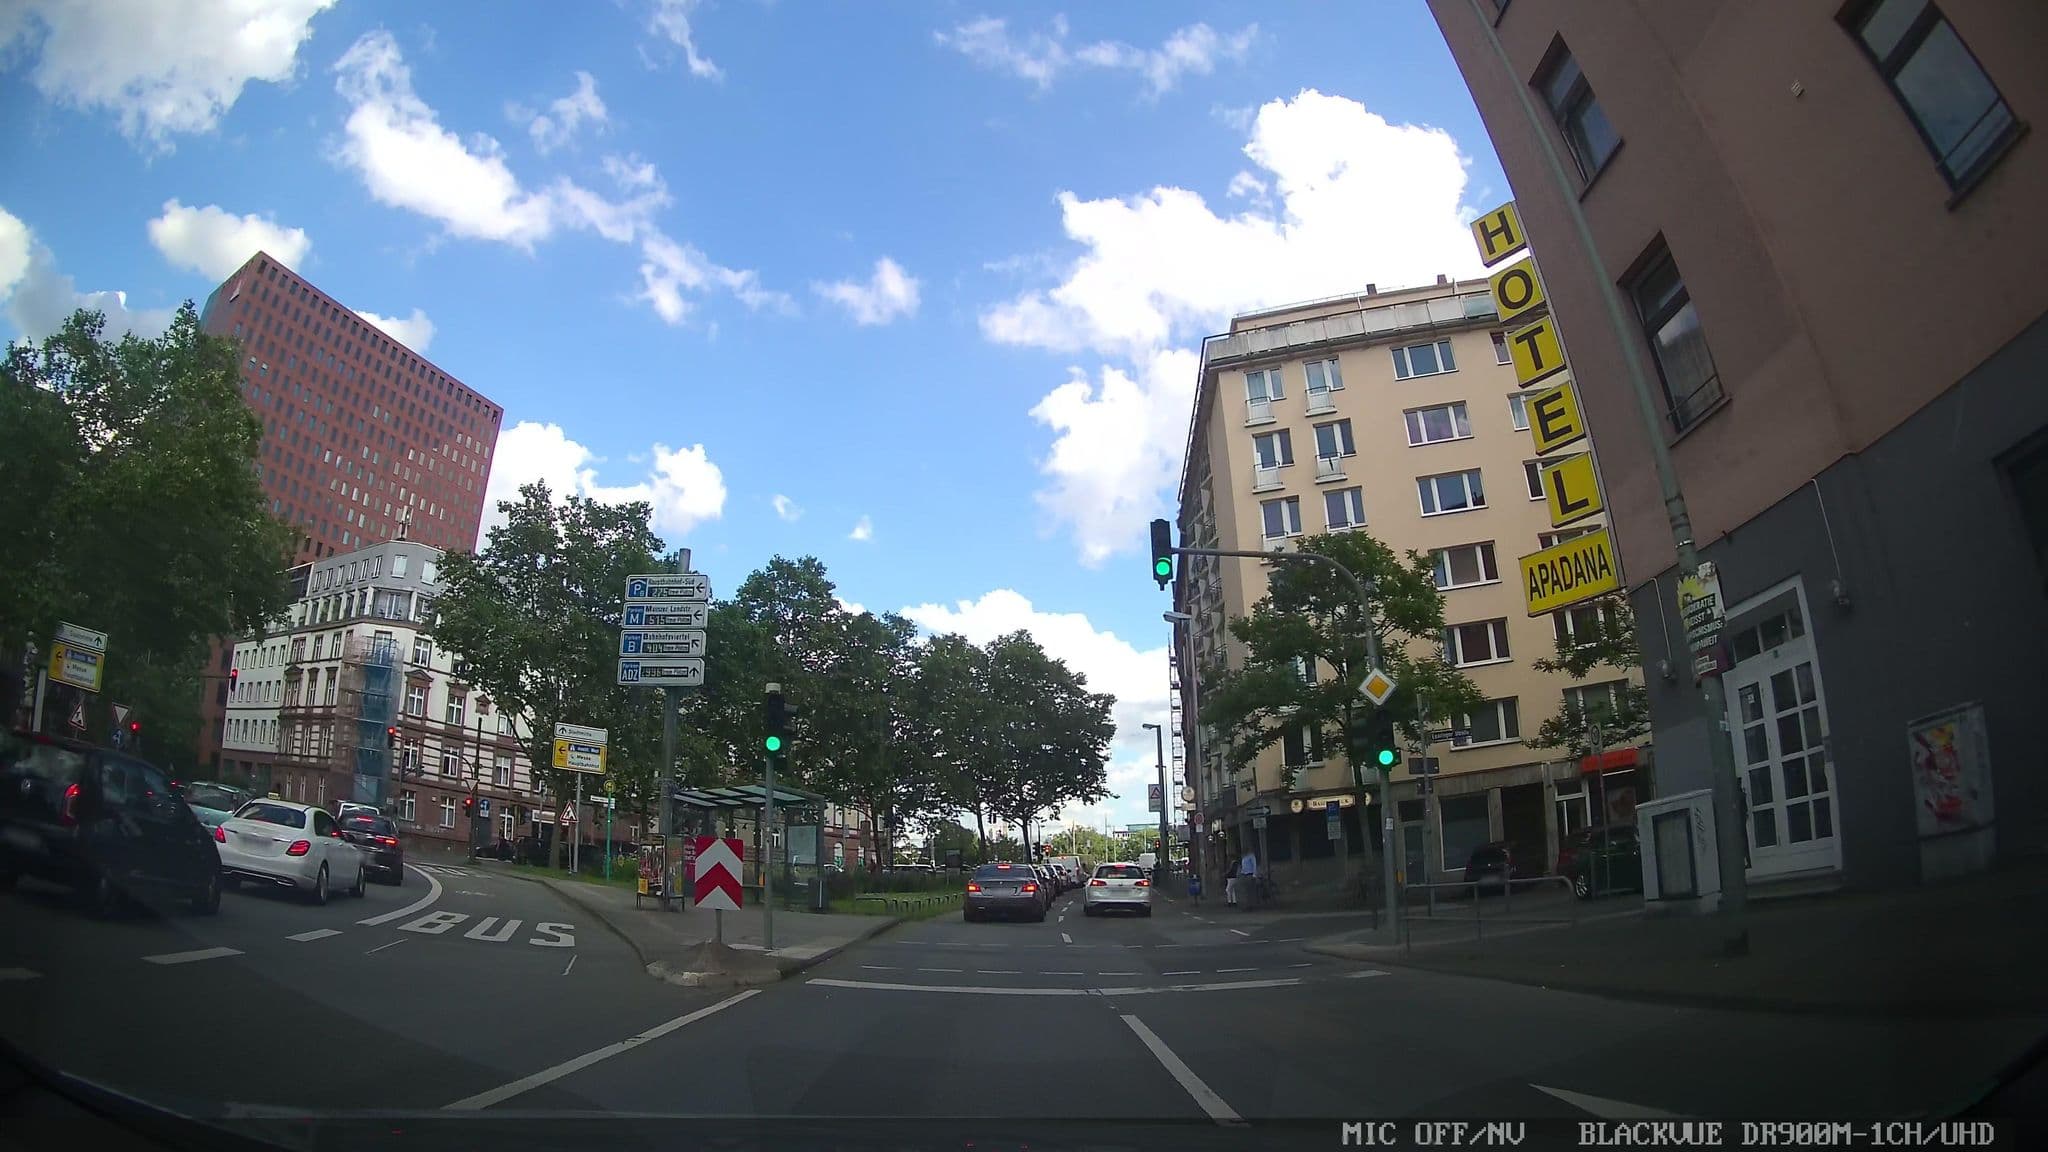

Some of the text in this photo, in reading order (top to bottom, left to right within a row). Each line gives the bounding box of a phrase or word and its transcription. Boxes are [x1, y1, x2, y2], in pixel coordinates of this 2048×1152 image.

[1479, 210, 1590, 515] HOTEL
[1528, 543, 1611, 602] APADANA
[629, 613, 639, 624] M
[1681, 595, 1716, 618] KRATIE
[628, 641, 636, 652] B
[396, 910, 576, 948] BUS
